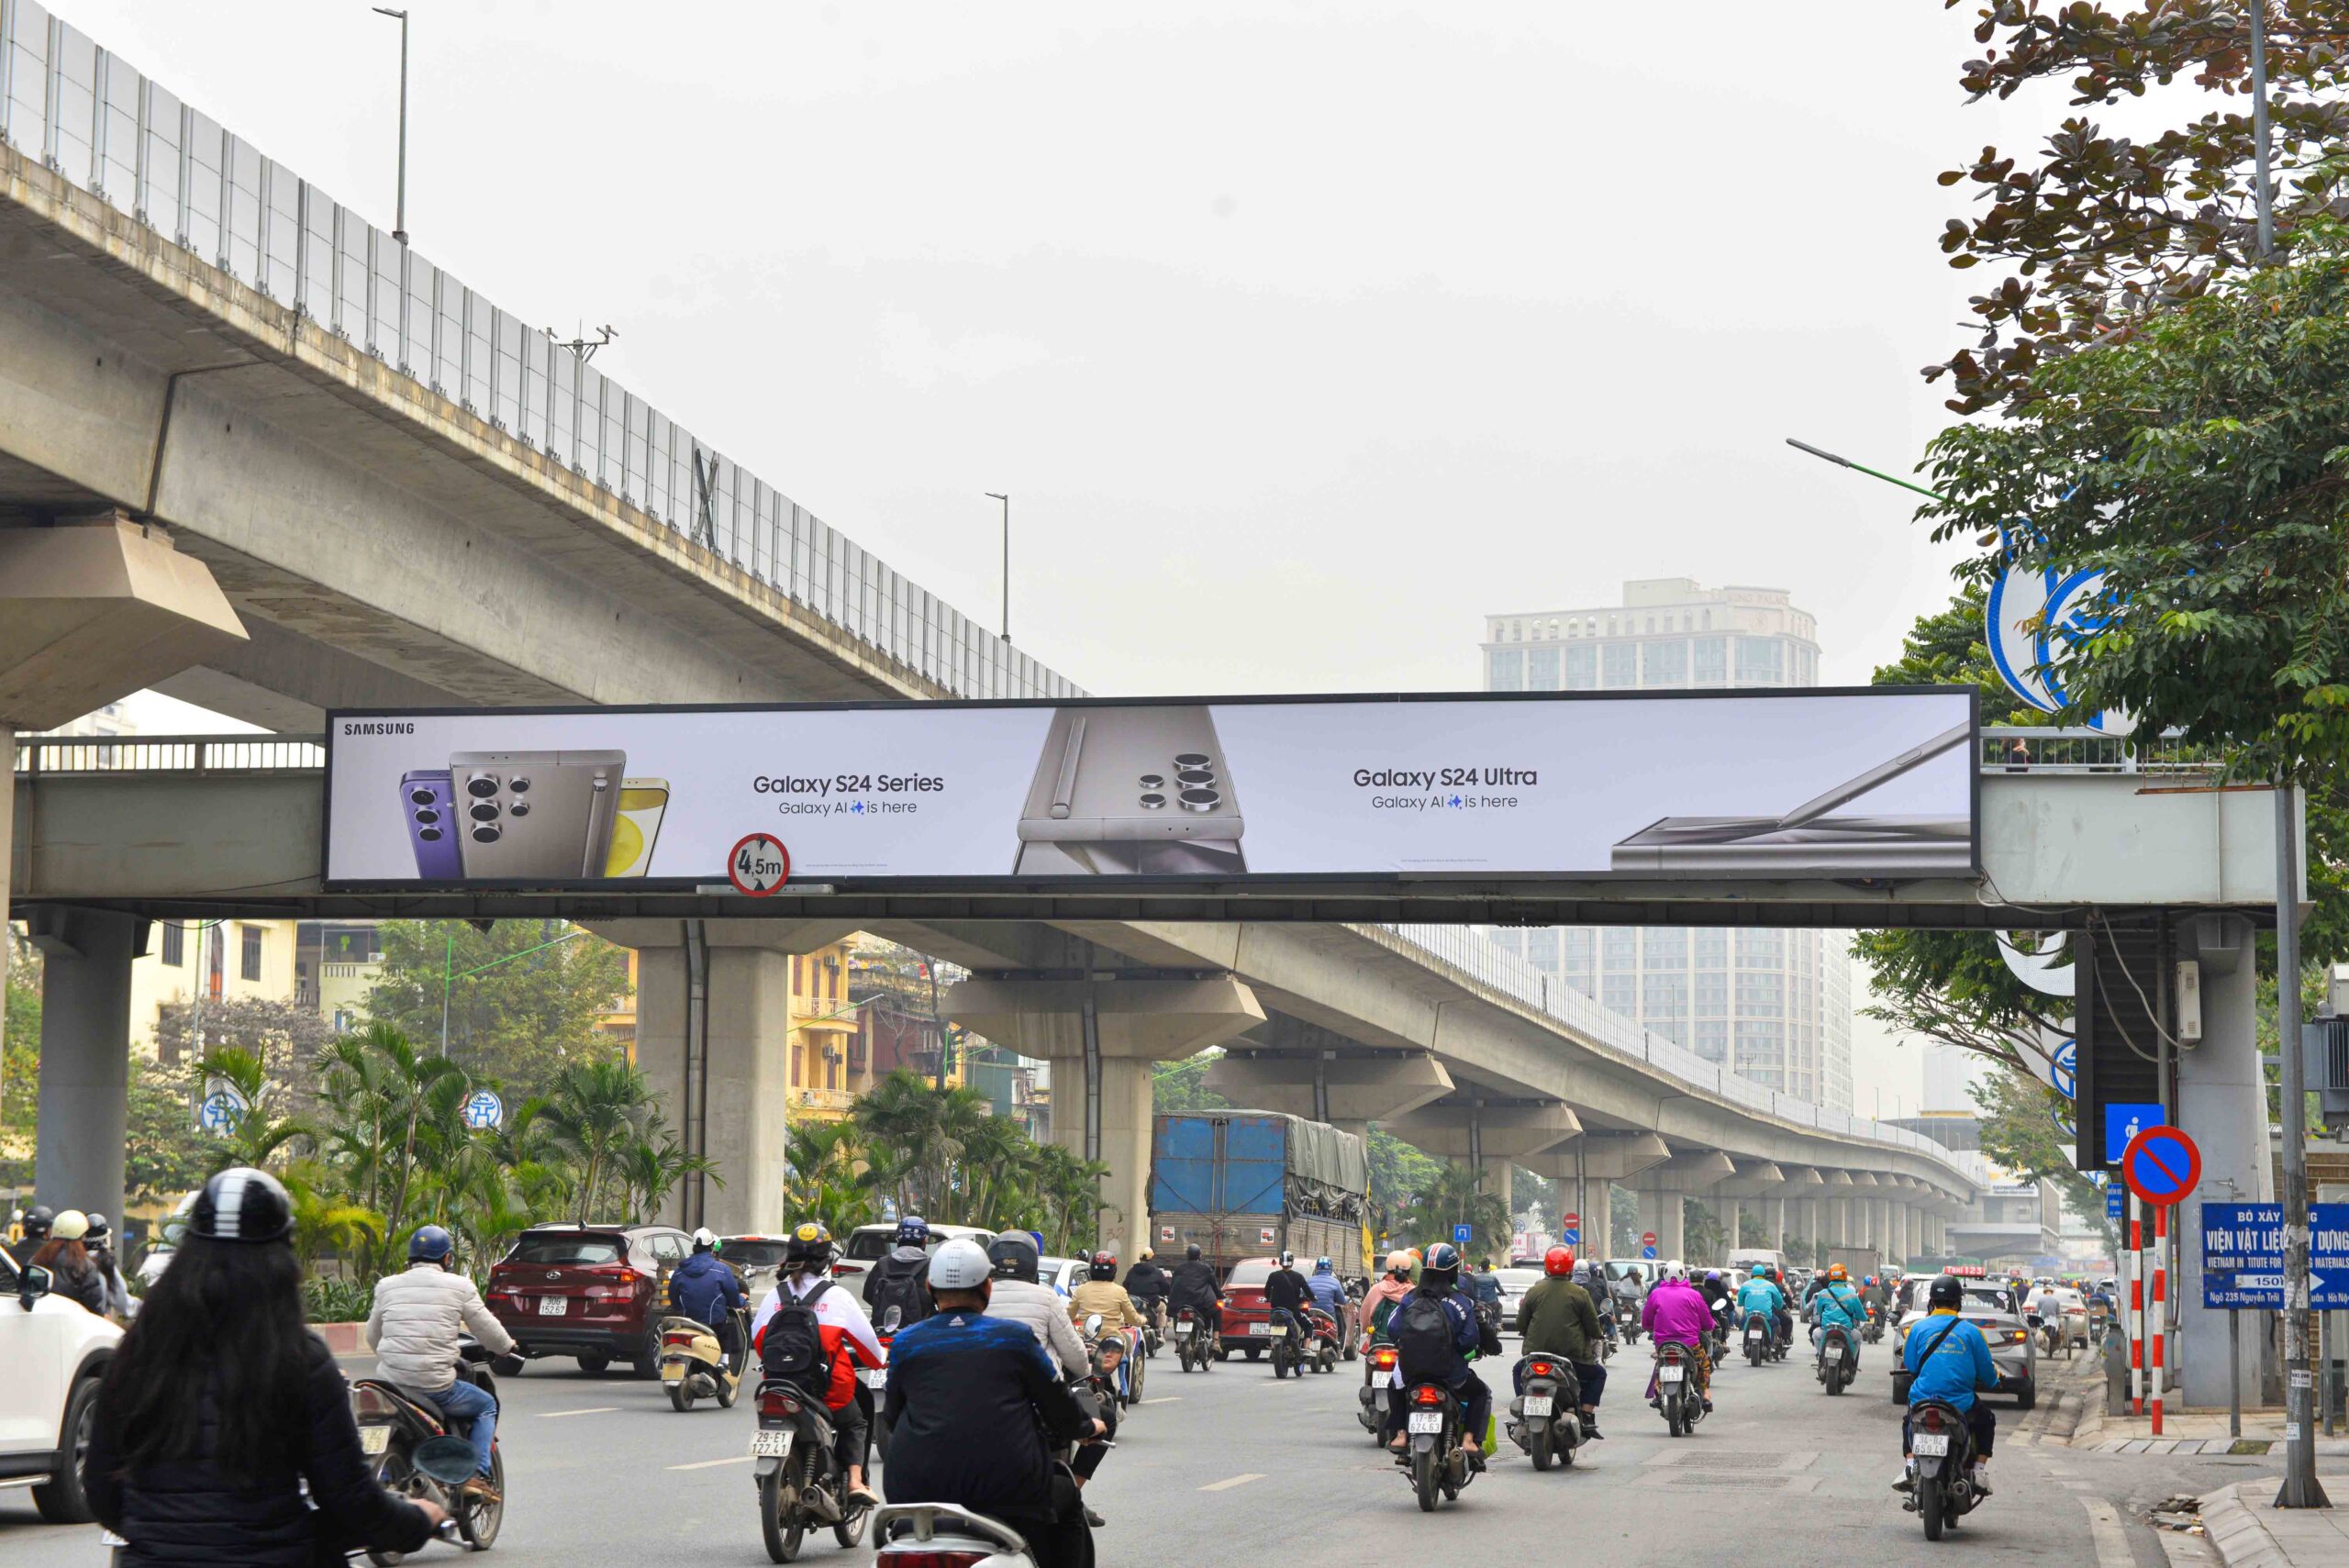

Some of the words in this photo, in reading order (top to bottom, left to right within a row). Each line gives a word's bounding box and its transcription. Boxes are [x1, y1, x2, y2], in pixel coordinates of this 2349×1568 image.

[344, 722, 415, 735] SAMSUNG
[753, 775, 831, 797] Galaxy
[835, 774, 872, 793] S24
[877, 773, 944, 792] Series
[1353, 769, 1435, 791] Galaxy
[1441, 768, 1478, 786] S24
[1485, 768, 1537, 785] Ultra
[779, 802, 831, 817] Galaxy
[834, 802, 847, 814] AI
[867, 801, 878, 813] is
[882, 801, 918, 813] here
[1372, 795, 1427, 812] Galaxy
[1431, 795, 1444, 808] AI
[1464, 795, 1476, 807] is
[1481, 795, 1518, 807] here
[738, 849, 781, 877] 4,5m
[2258, 1209, 2281, 1222] XÂY
[2206, 1227, 2233, 1253] VIỆN
[2236, 1227, 2258, 1254] VẬT
[2318, 1229, 2349, 1254] DỰNG
[2207, 1257, 2235, 1268] VIETNAM
[2236, 1257, 2268, 1268] INTITUTE
[2270, 1257, 2282, 1268] FOR
[2315, 1257, 2349, 1269] MATERIALS
[2310, 1293, 2324, 1302] uân
[2328, 1292, 2338, 1302] Hà
[2338, 1293, 2349, 1304] Nộ
[757, 1432, 786, 1443] 29-E1
[752, 1443, 786, 1455] 127.41
